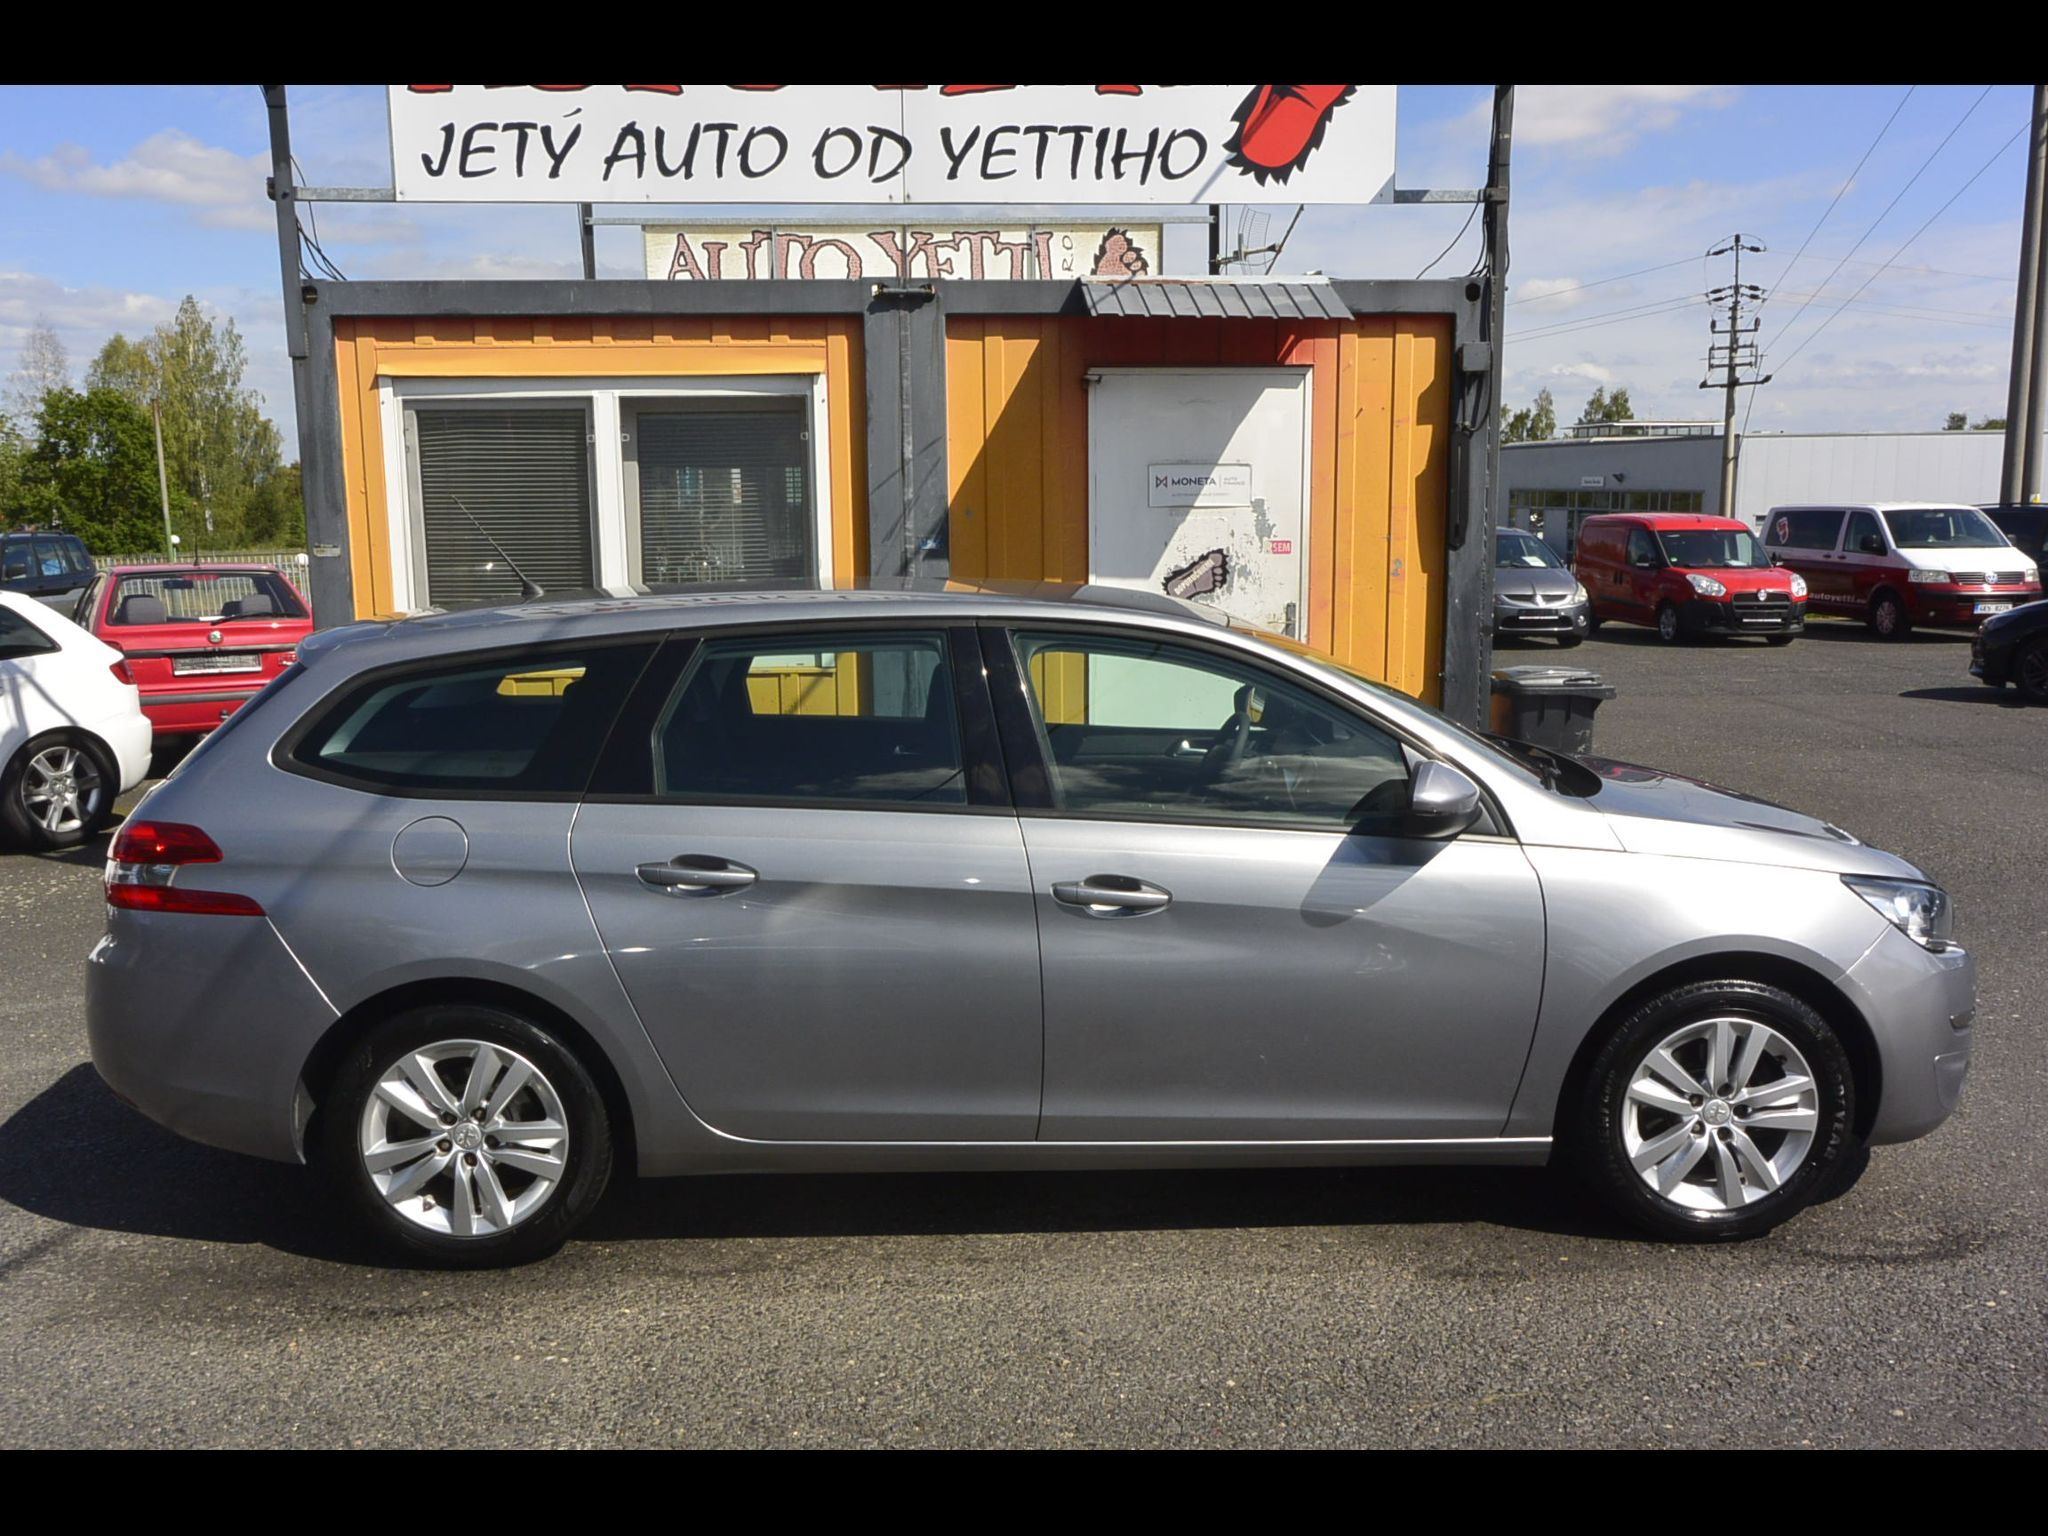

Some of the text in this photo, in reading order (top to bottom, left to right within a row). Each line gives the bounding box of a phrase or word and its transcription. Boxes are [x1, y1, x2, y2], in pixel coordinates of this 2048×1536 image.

[421, 107, 1209, 186] JETÝ AUTO OD YETTIHO
[1171, 476, 1217, 487] MONETA
[1272, 542, 1290, 553] SEM
